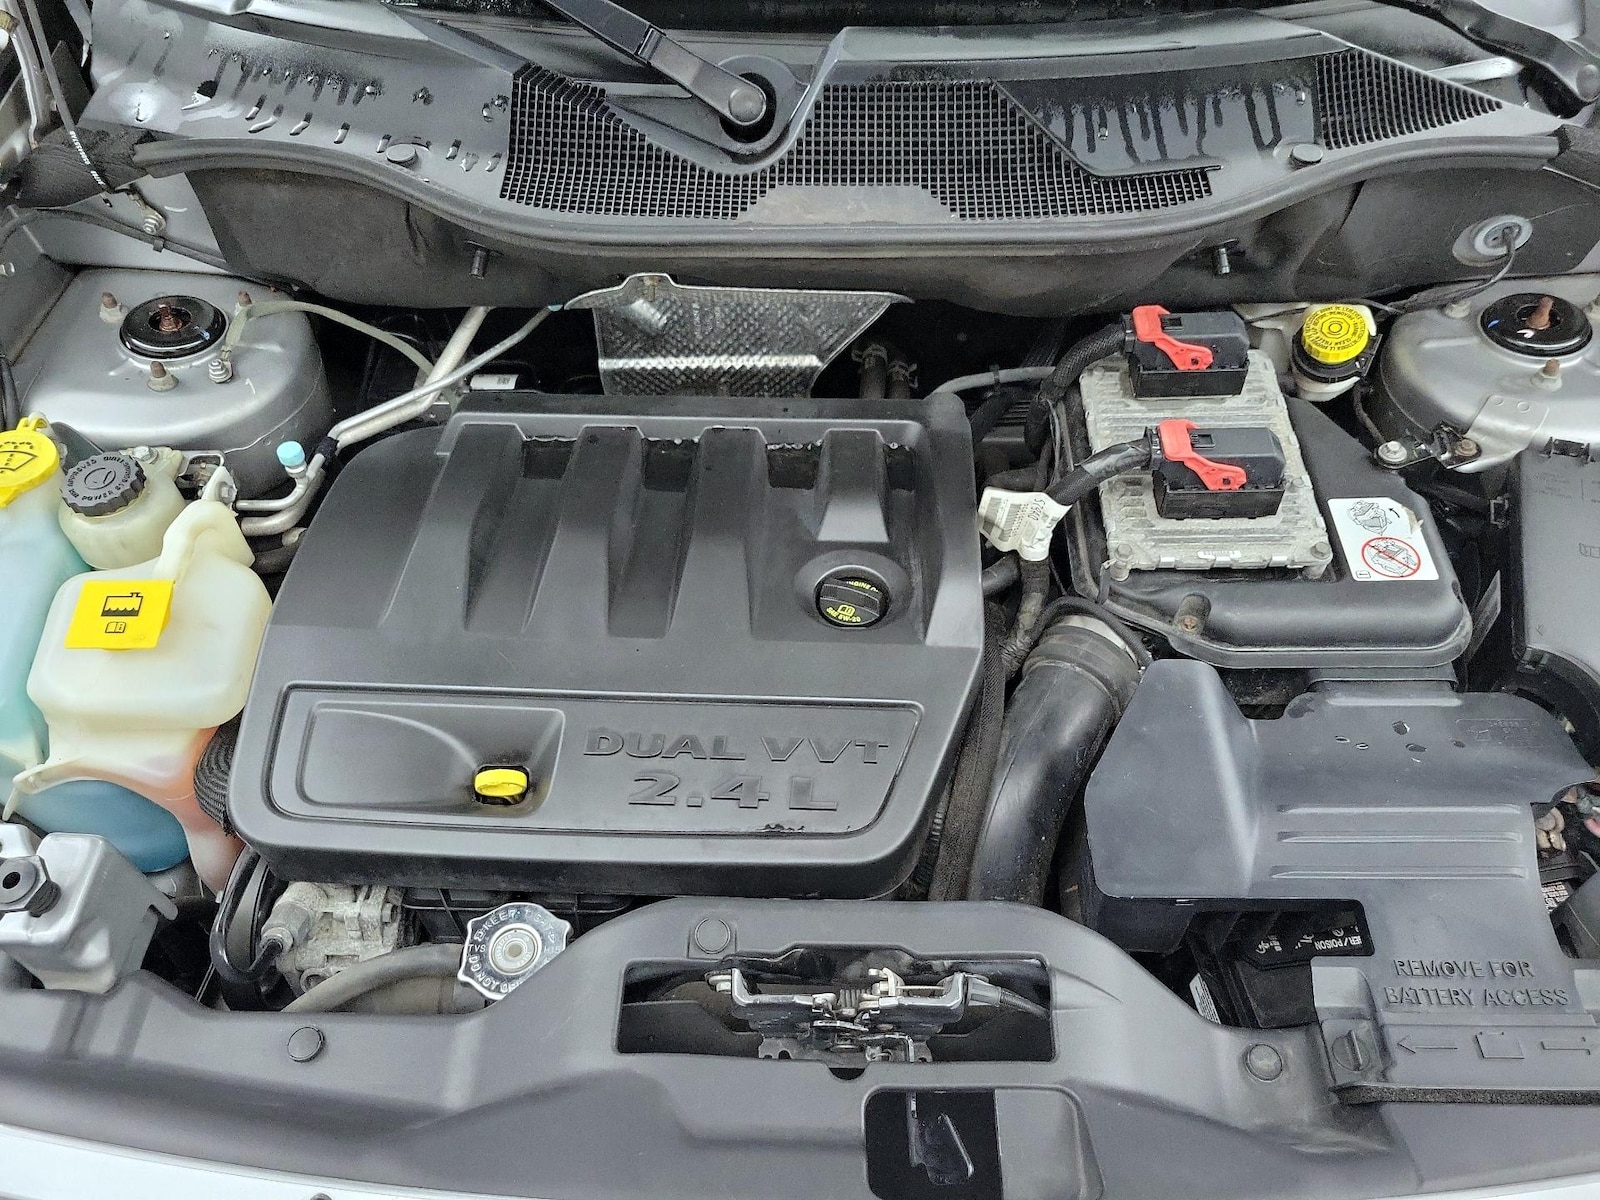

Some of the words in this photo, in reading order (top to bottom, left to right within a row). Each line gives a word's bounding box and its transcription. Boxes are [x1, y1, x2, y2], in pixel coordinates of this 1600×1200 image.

[583, 728, 746, 760] DUAL
[760, 735, 889, 764] VVT
[628, 770, 770, 809] 2.4
[788, 775, 838, 811] L
[468, 944, 486, 953] TVS
[1393, 958, 1485, 978] REMOVE
[1489, 960, 1535, 978] FOR
[1383, 986, 1474, 1006] BATTERY
[1484, 988, 1569, 1007] ACCESS
